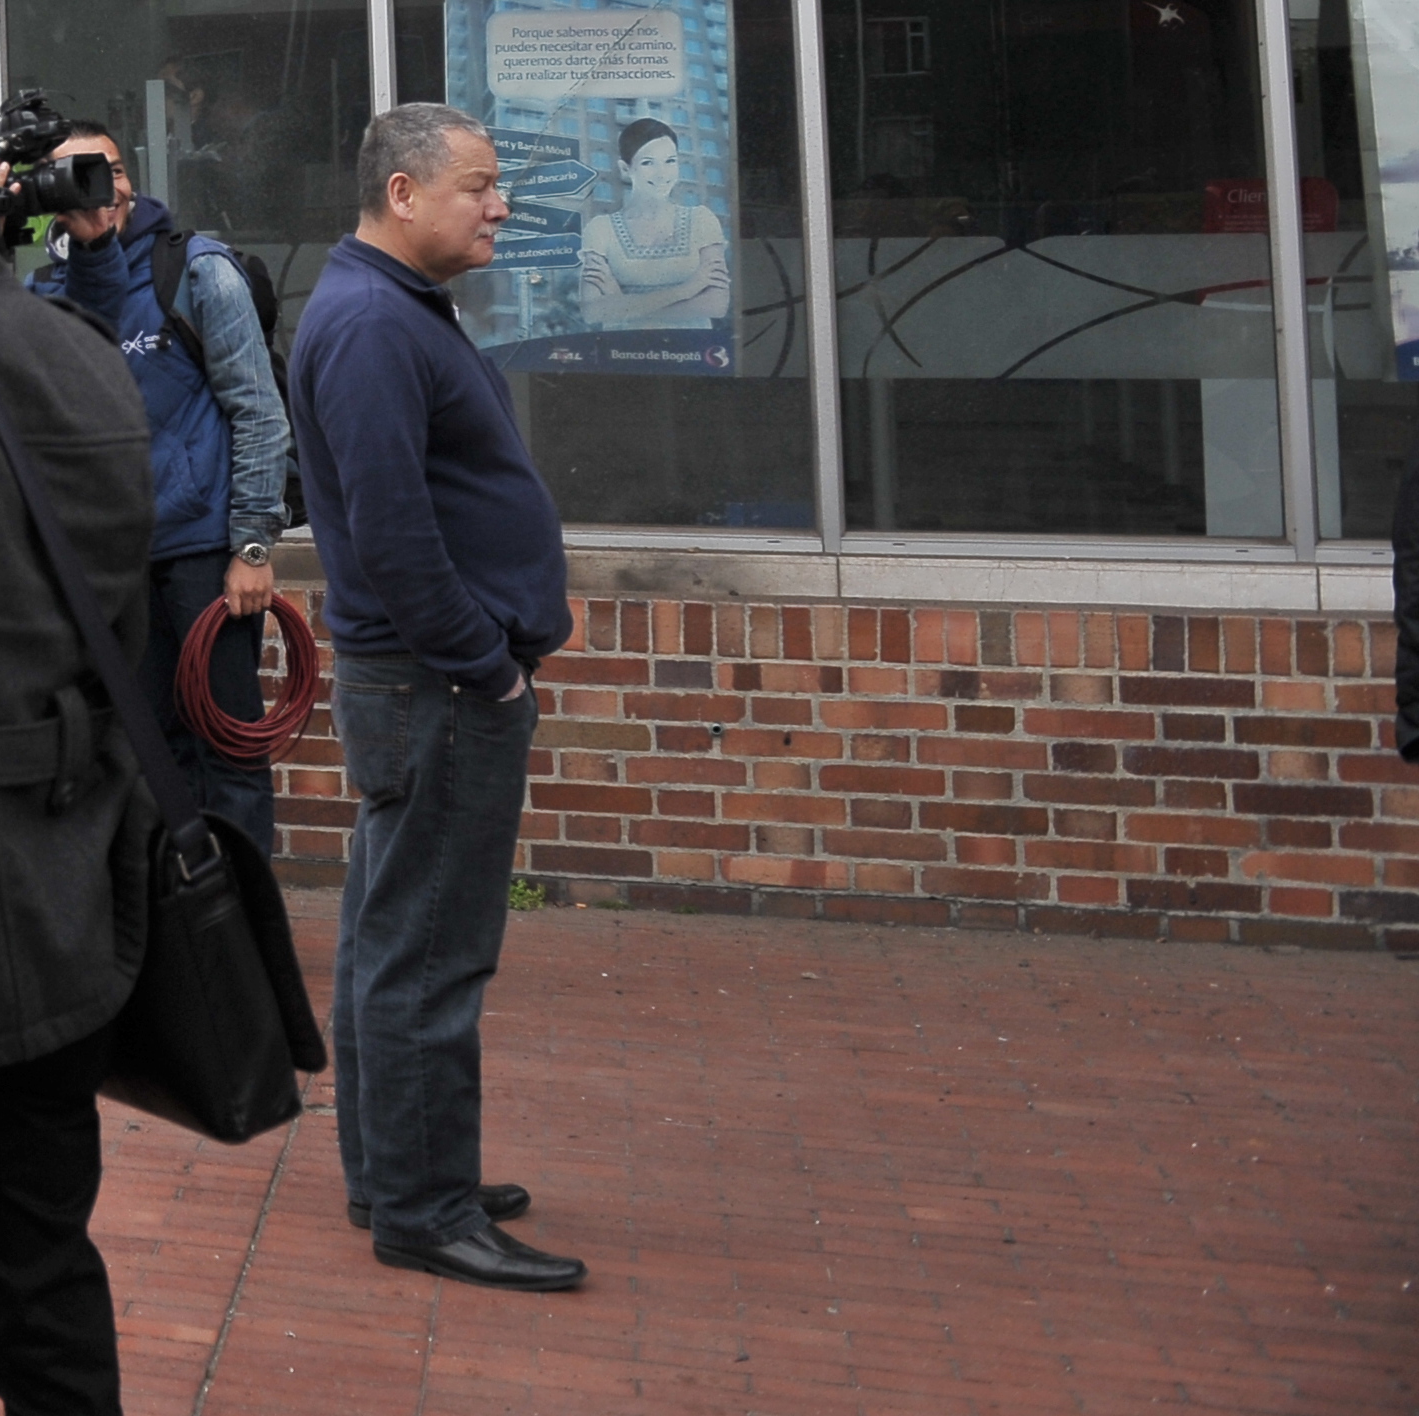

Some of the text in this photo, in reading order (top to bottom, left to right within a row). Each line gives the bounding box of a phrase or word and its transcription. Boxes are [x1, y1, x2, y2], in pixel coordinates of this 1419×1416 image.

[512, 26, 659, 40] Porque sabemos que nos
[495, 42, 538, 54] puedes
[540, 41, 591, 52] necesitar
[596, 43, 610, 51] en
[613, 41, 626, 52] tu
[503, 54, 668, 68] queremos darte más formas
[497, 69, 675, 82] para realizar tus transacciones.
[518, 141, 545, 152] Banca
[538, 172, 578, 184] Bancario
[504, 249, 516, 260] de
[517, 246, 573, 259] autoservicio
[610, 349, 645, 361] Banco
[646, 349, 661, 361] de
[661, 349, 702, 363] Bogotá
